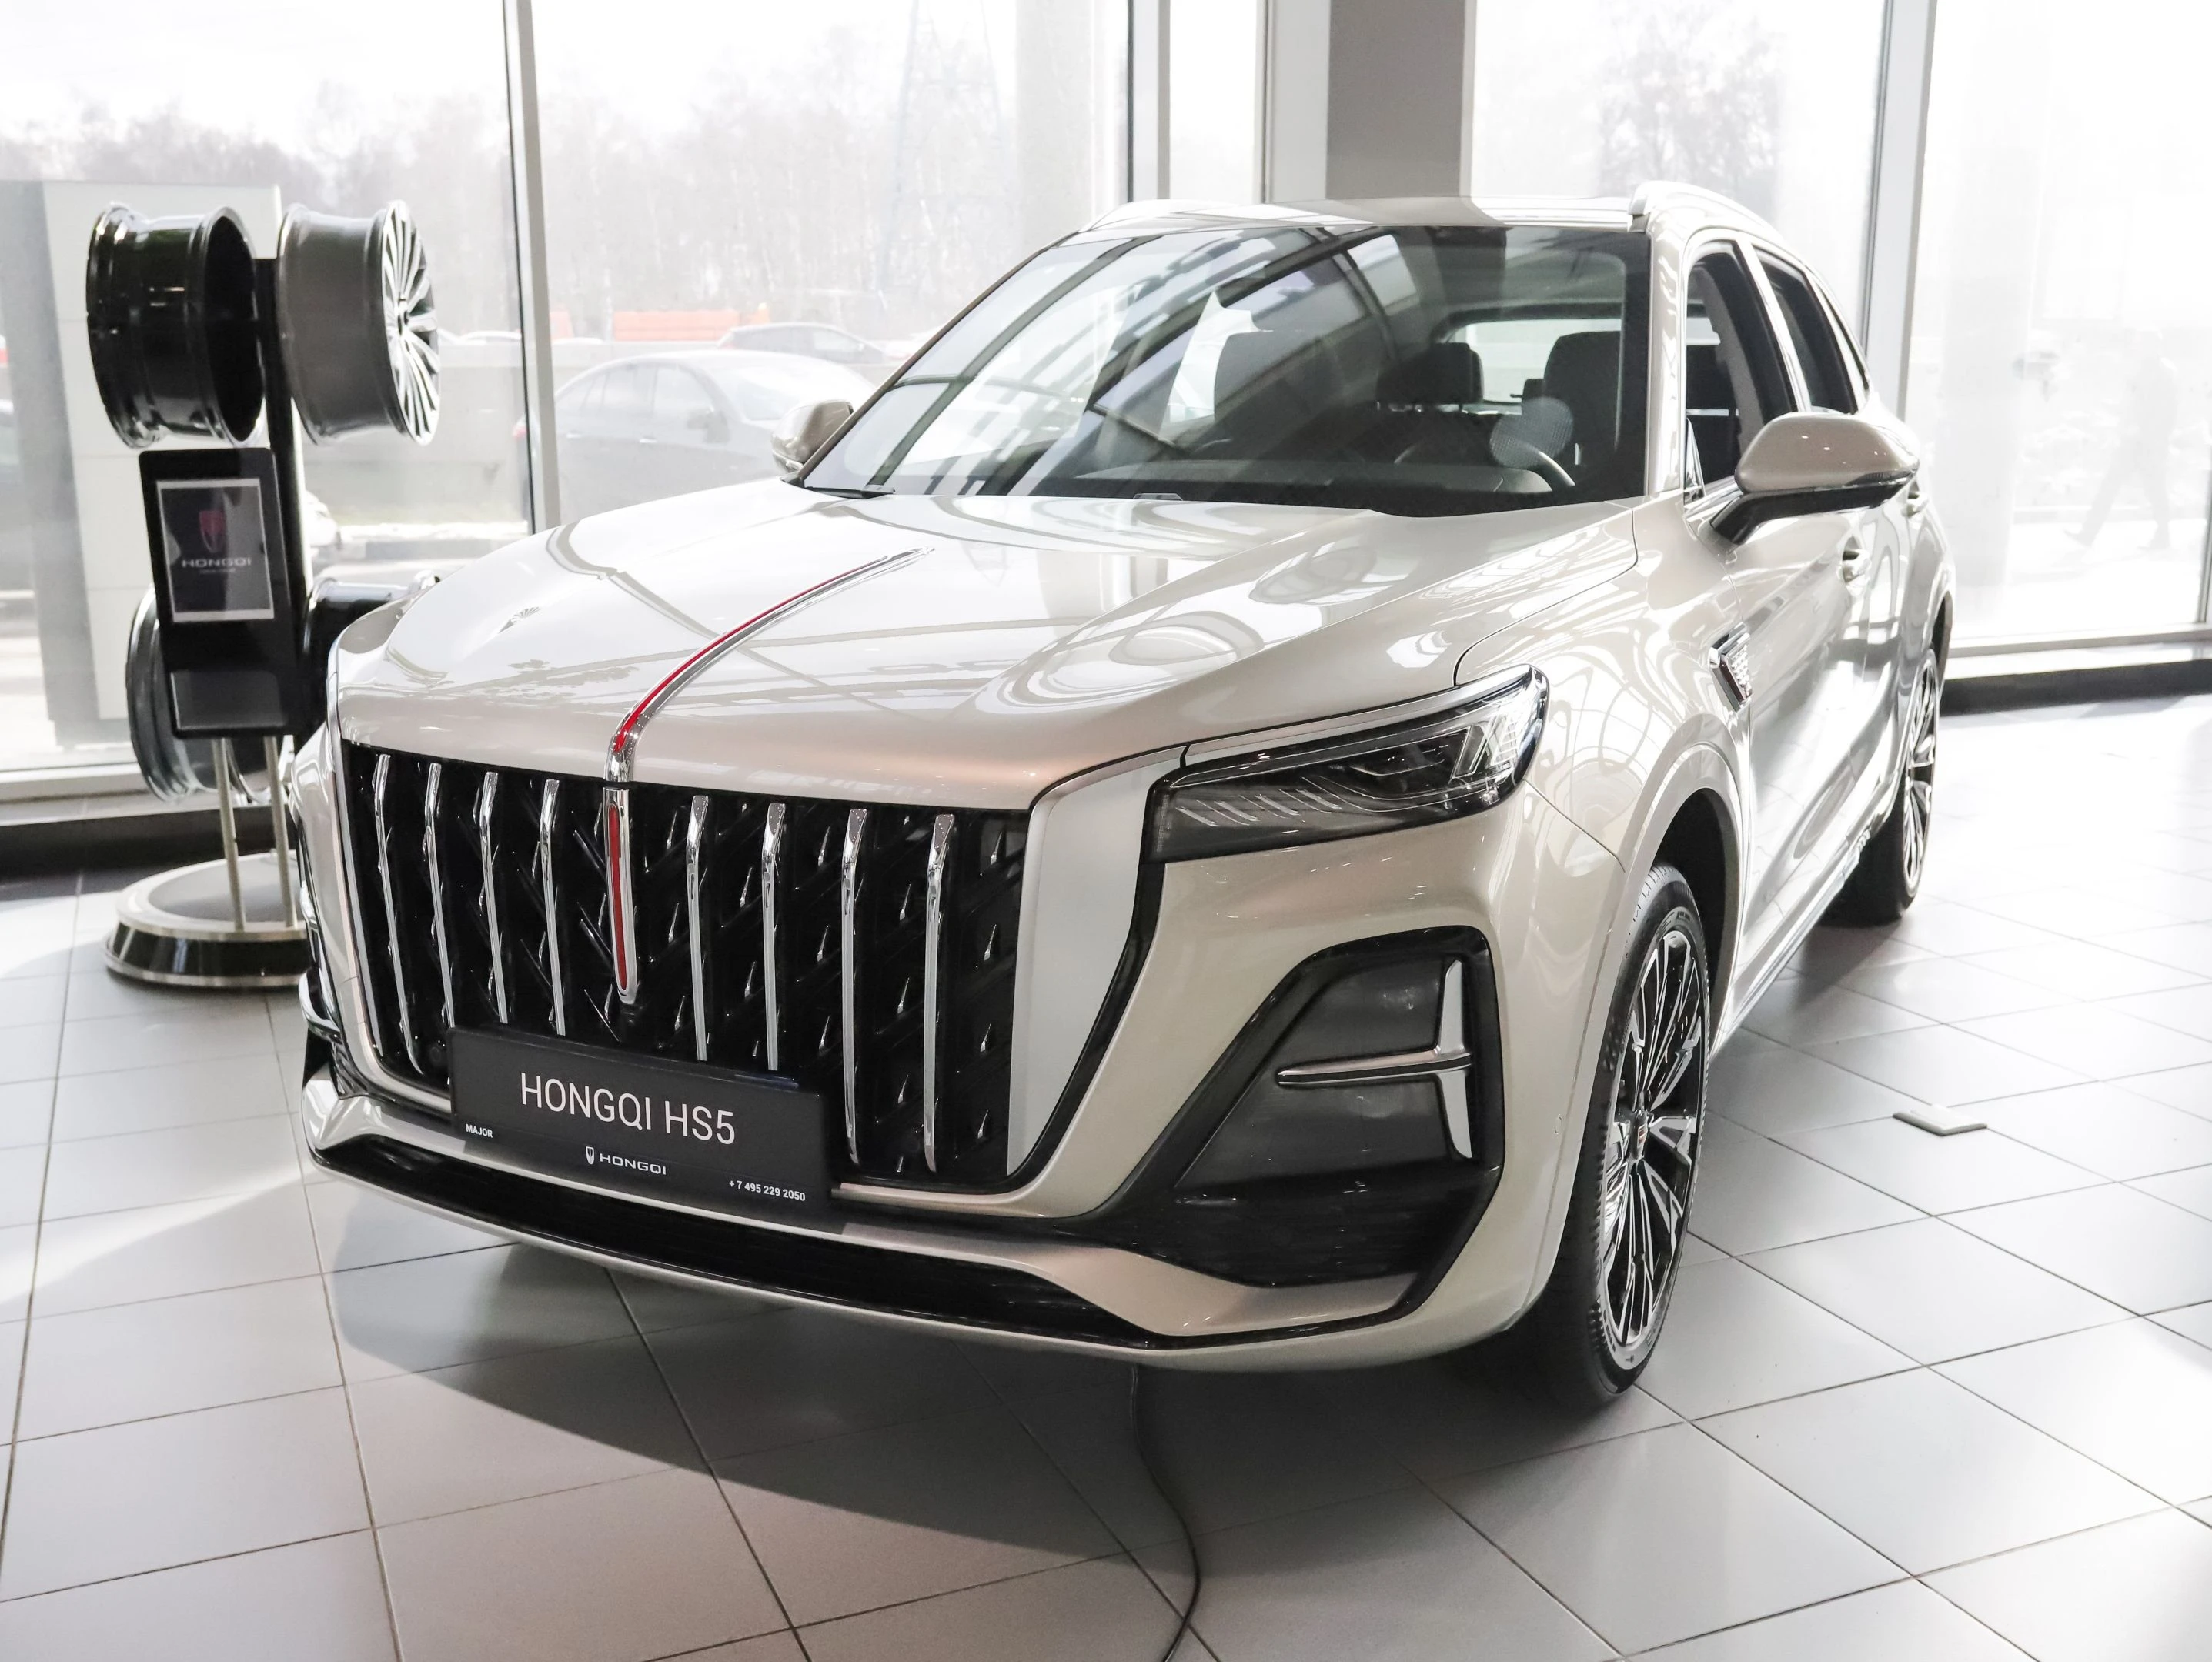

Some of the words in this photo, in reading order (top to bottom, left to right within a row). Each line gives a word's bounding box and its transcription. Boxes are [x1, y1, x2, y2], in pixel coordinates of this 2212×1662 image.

[520, 1073, 653, 1131] HONGQI
[664, 1100, 736, 1145] HS5
[466, 1123, 493, 1139] MAJOR
[600, 1153, 667, 1175] HONGQI
[744, 1182, 761, 1193] 495
[763, 1186, 780, 1196] 229
[782, 1189, 806, 1201] 2050
